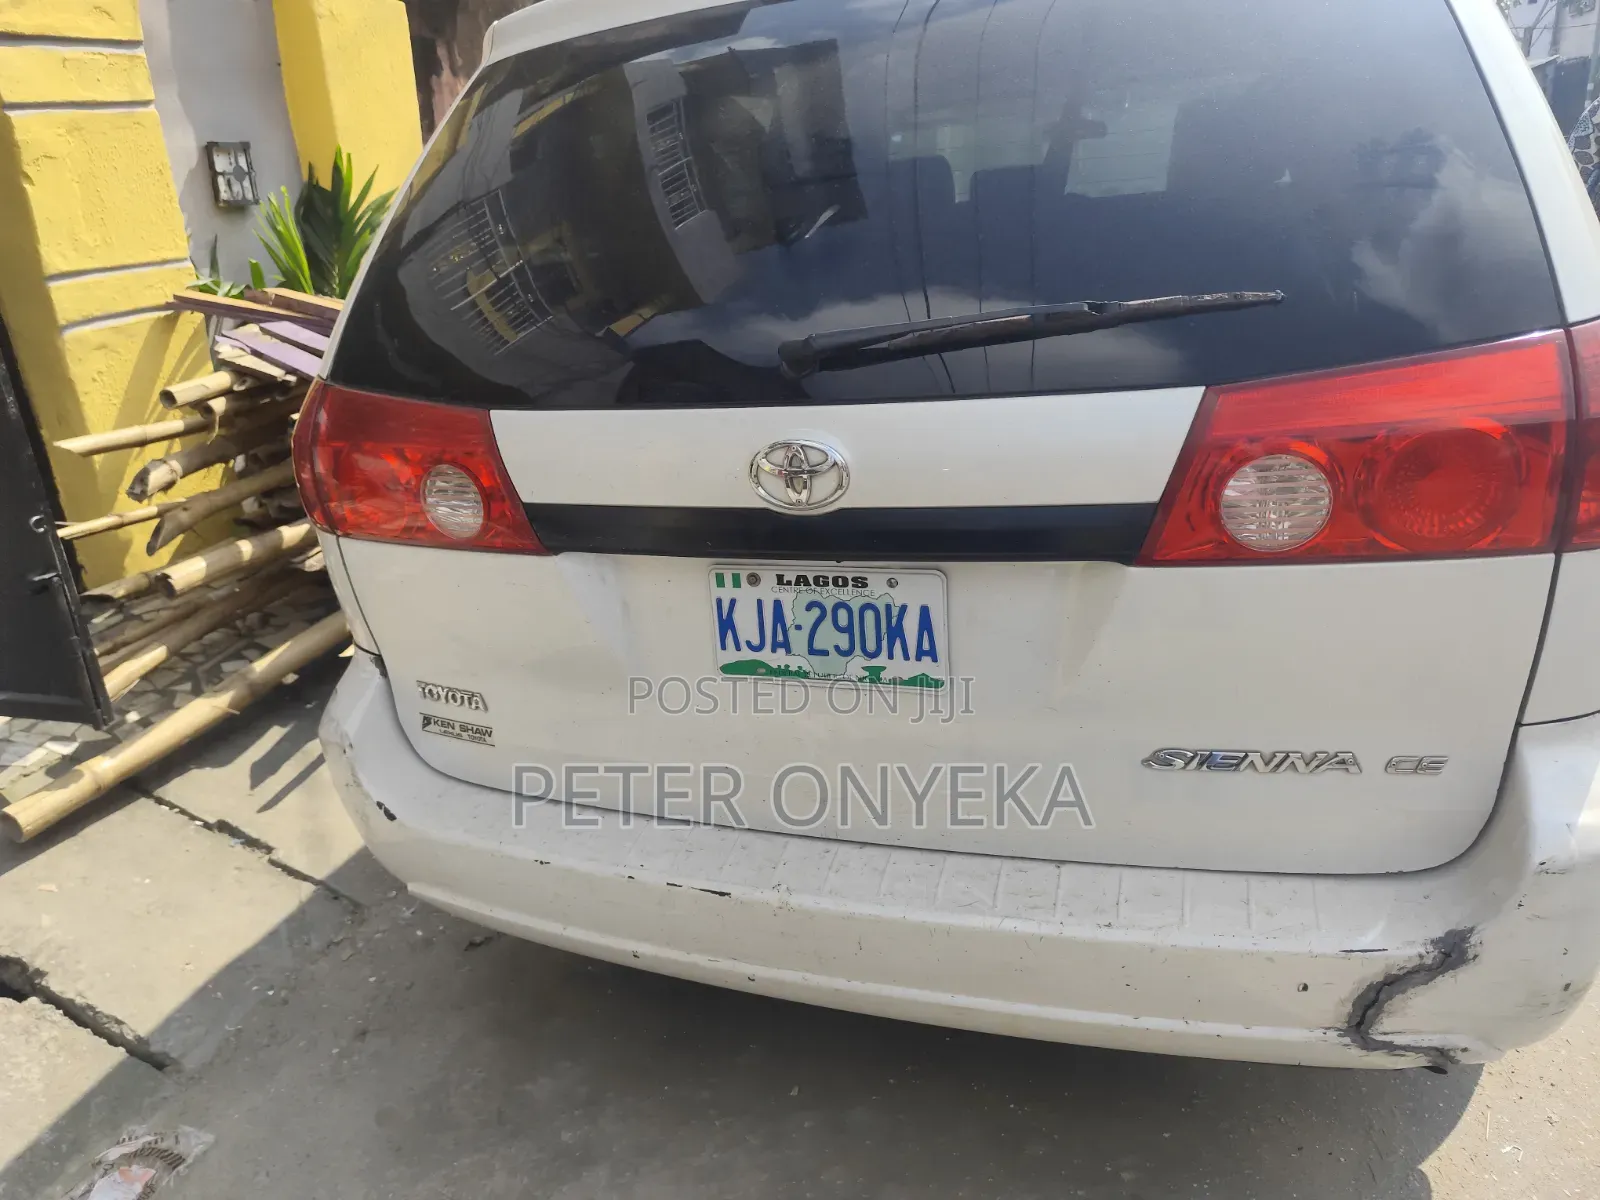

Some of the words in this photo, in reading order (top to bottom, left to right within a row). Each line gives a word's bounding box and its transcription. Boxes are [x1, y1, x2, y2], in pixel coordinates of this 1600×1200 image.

[771, 586, 804, 595] CENTRE
[820, 587, 876, 597] EXCELLENCE
[776, 573, 869, 588] LAGOS
[716, 597, 938, 662] KJA-290KA
[416, 680, 489, 713] TOYOTA
[433, 718, 456, 731] KEN
[459, 723, 493, 738] SHAW
[1141, 747, 1362, 774] SIENNA
[1384, 755, 1449, 775] CE
